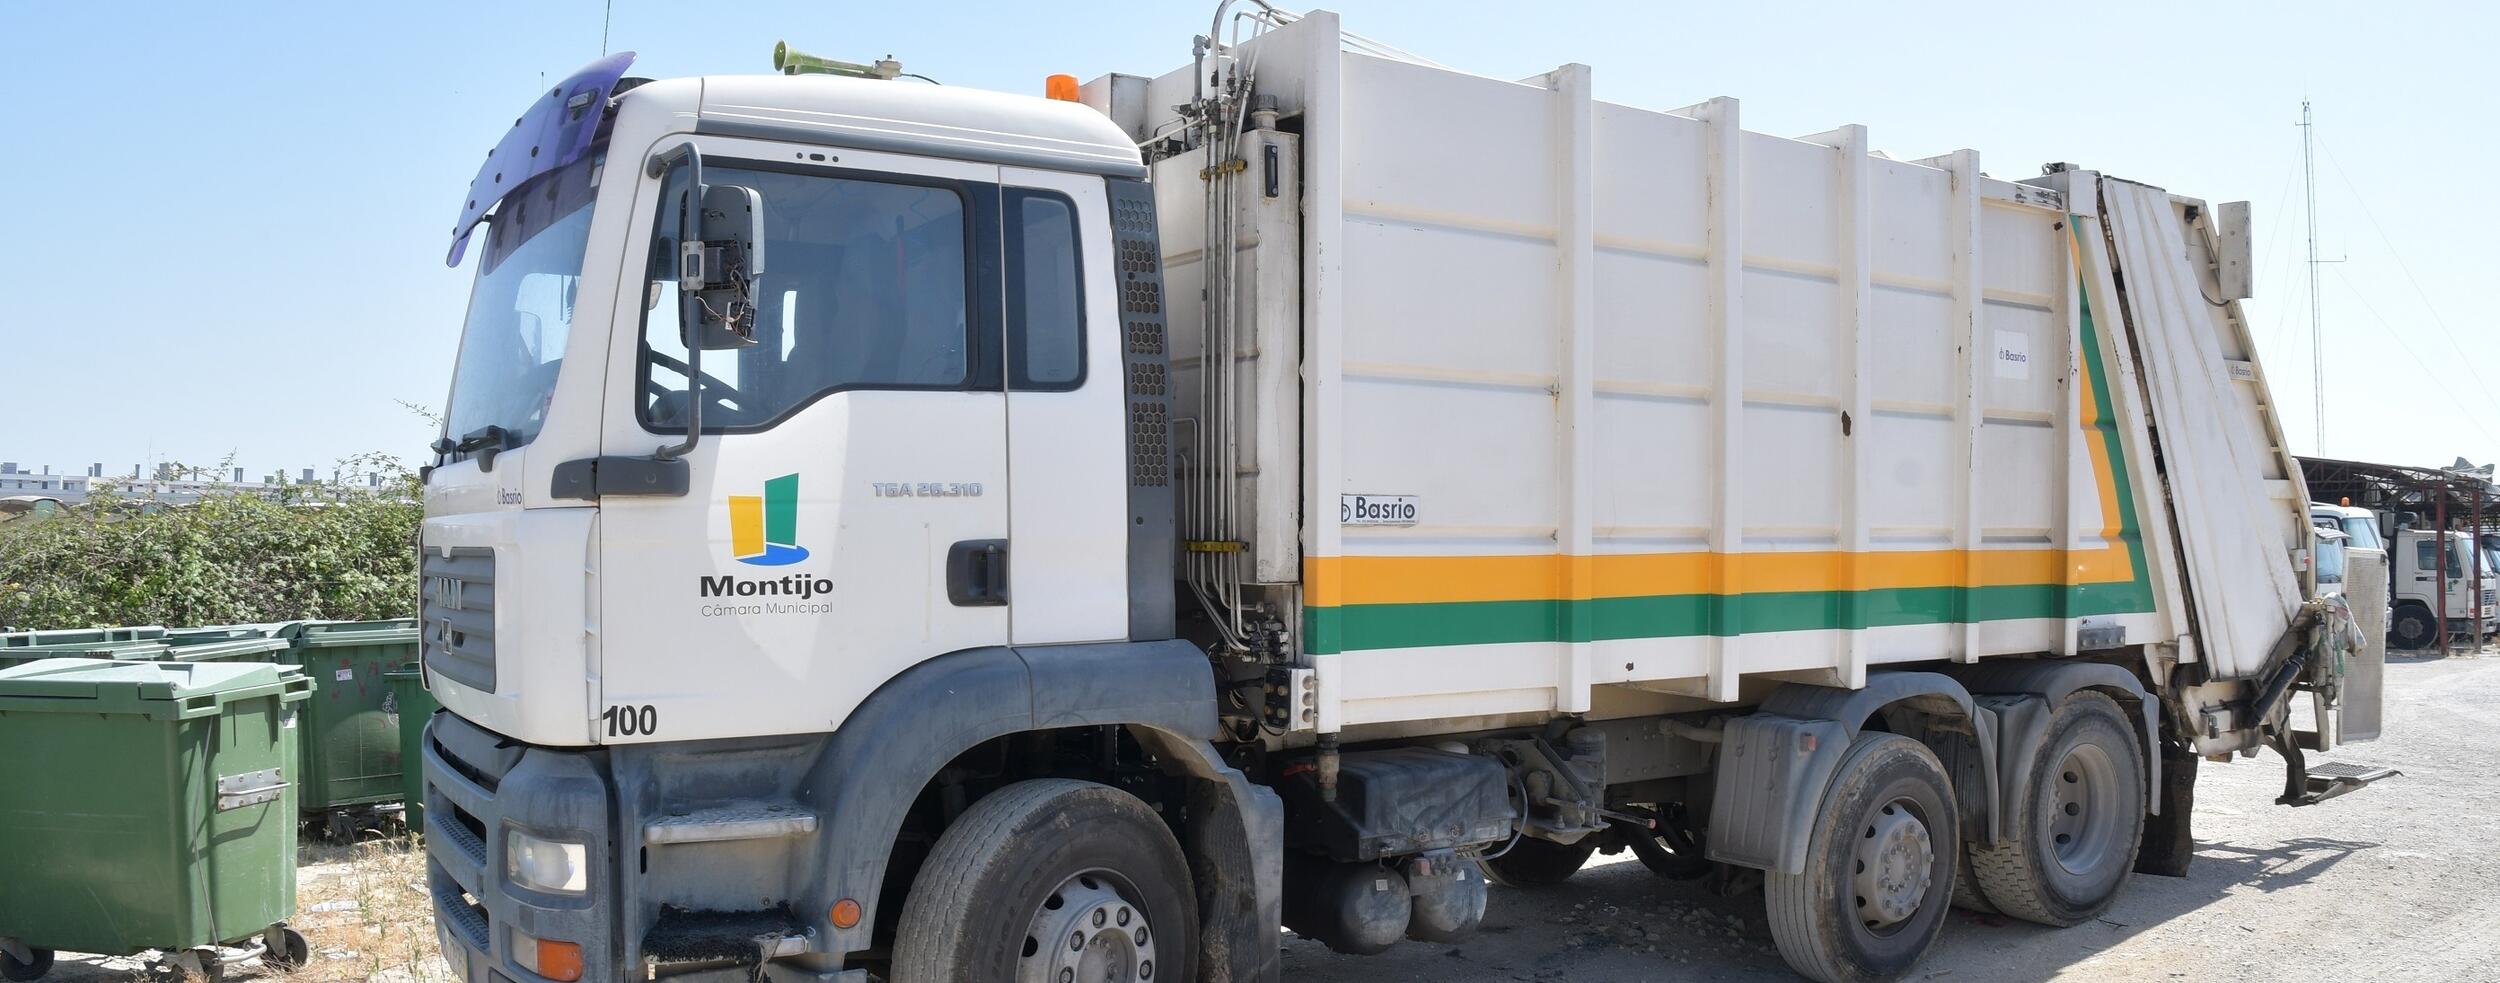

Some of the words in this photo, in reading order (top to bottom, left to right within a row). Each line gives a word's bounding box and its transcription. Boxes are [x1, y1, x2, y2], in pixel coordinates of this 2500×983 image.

[2005, 349, 2026, 362] Basrio
[501, 487, 523, 505] Basrio
[873, 482, 914, 498] TGA
[917, 482, 983, 498] 26.310
[1355, 496, 1416, 519] Basrio
[700, 573, 834, 600] Montijo
[701, 604, 761, 617] Câmara
[765, 601, 834, 616] Municipal
[602, 704, 658, 738] 100
